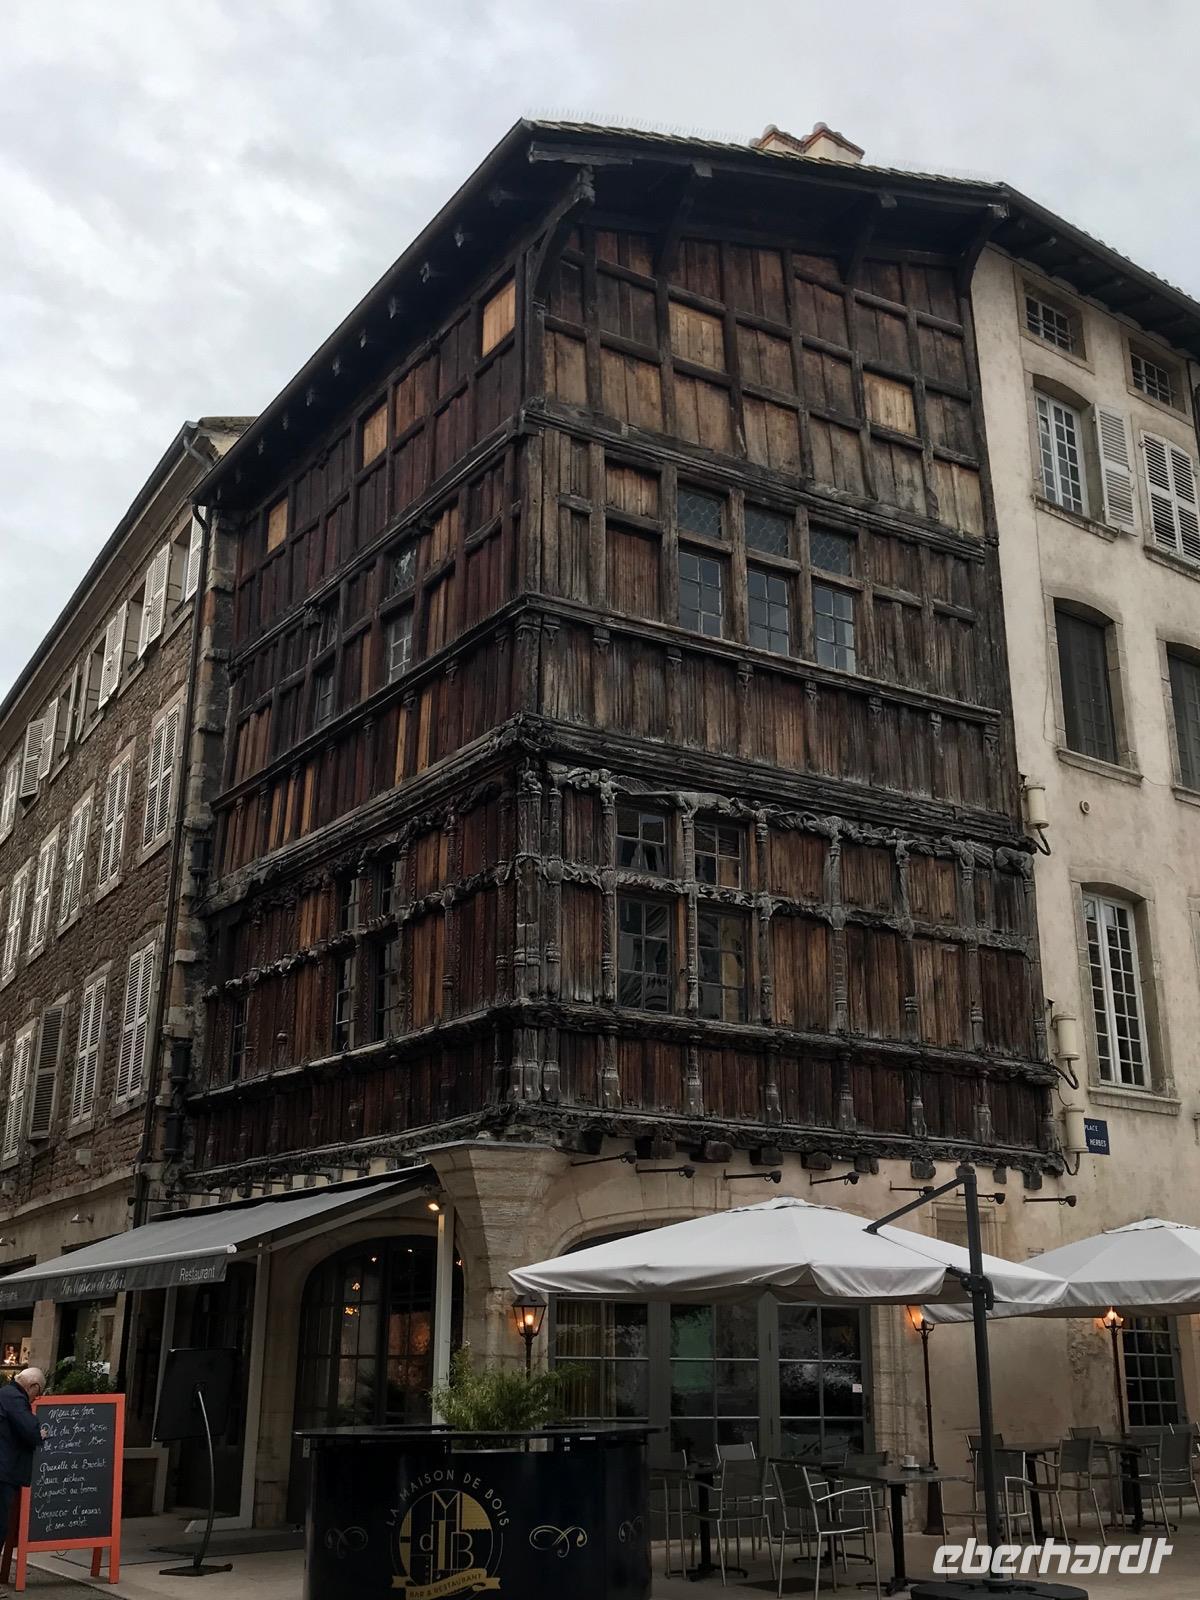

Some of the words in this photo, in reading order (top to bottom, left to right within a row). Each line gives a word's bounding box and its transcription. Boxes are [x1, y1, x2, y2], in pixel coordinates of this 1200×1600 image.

[179, 1266, 216, 1281] Restaurant
[70, 1459, 79, 1470] de
[386, 1507, 400, 1526] LA
[399, 1469, 455, 1502] MAISON
[463, 1472, 482, 1490] DE
[484, 1488, 510, 1527] BOIS
[433, 1573, 483, 1594] RESTAURANT
